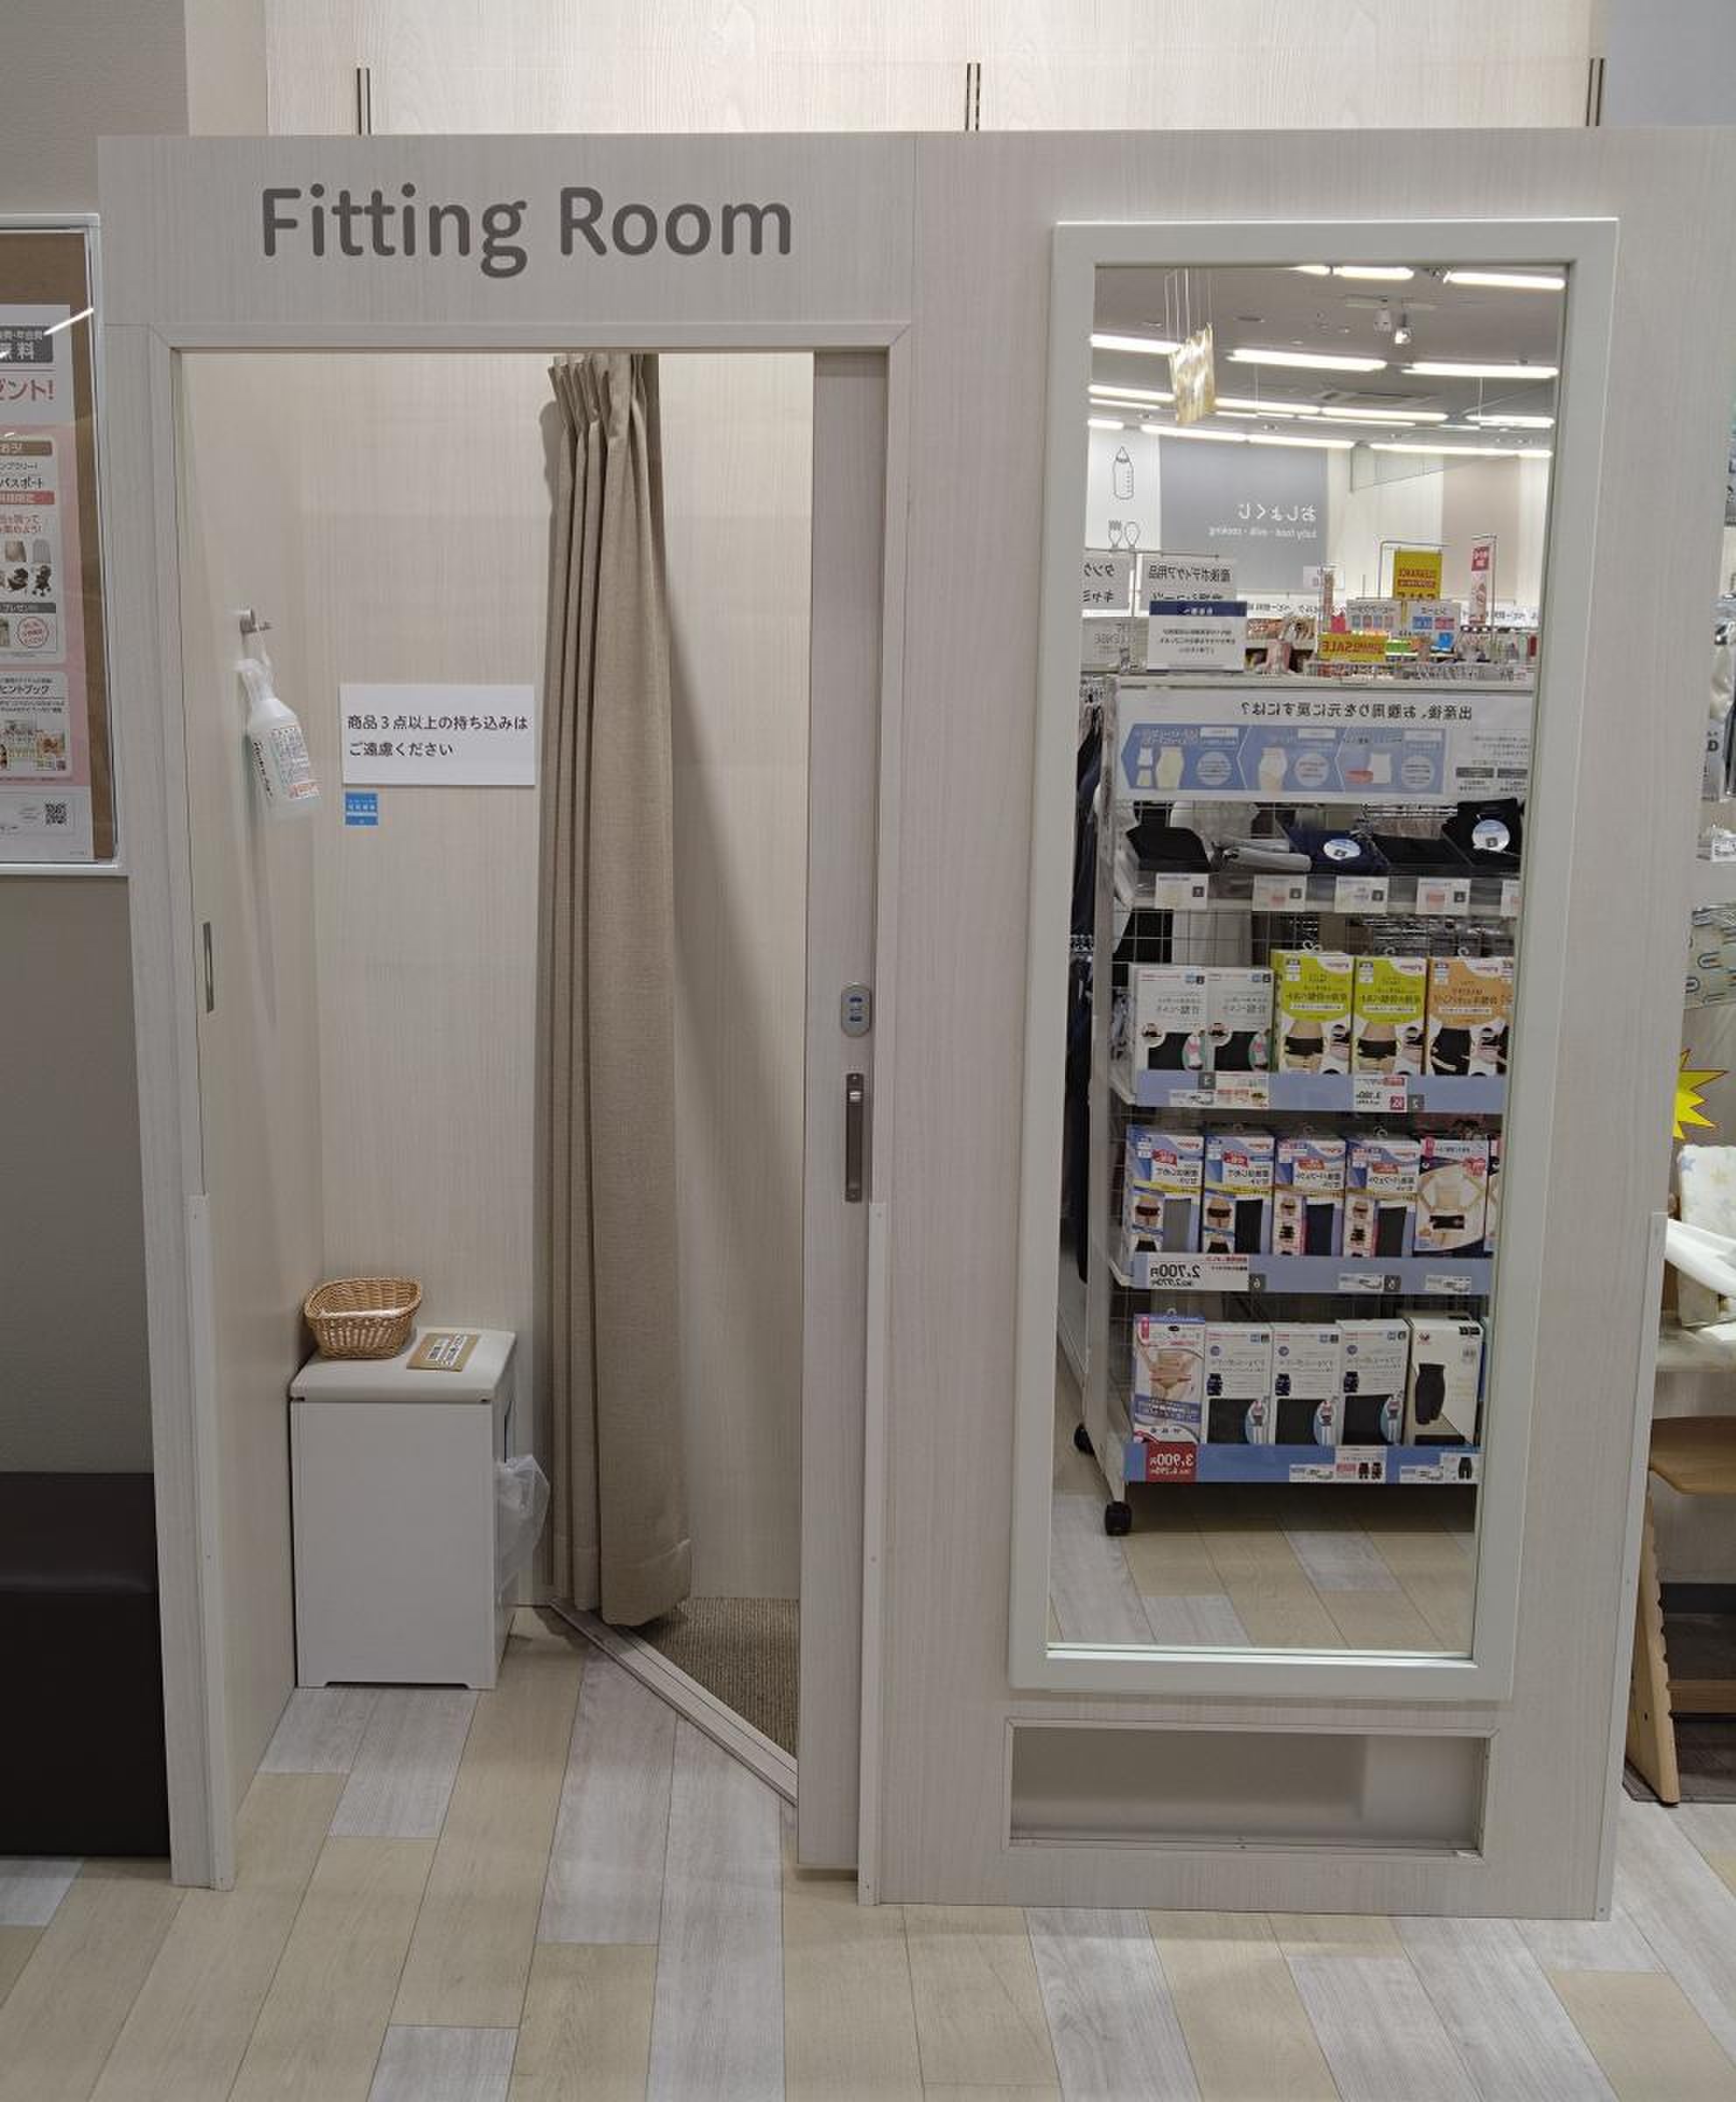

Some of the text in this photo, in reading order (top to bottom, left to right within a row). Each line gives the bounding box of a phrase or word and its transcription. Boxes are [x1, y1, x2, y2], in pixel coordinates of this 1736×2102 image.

[262, 182, 792, 279] Fitting Room
[349, 741, 454, 758] ご遠慮ください
